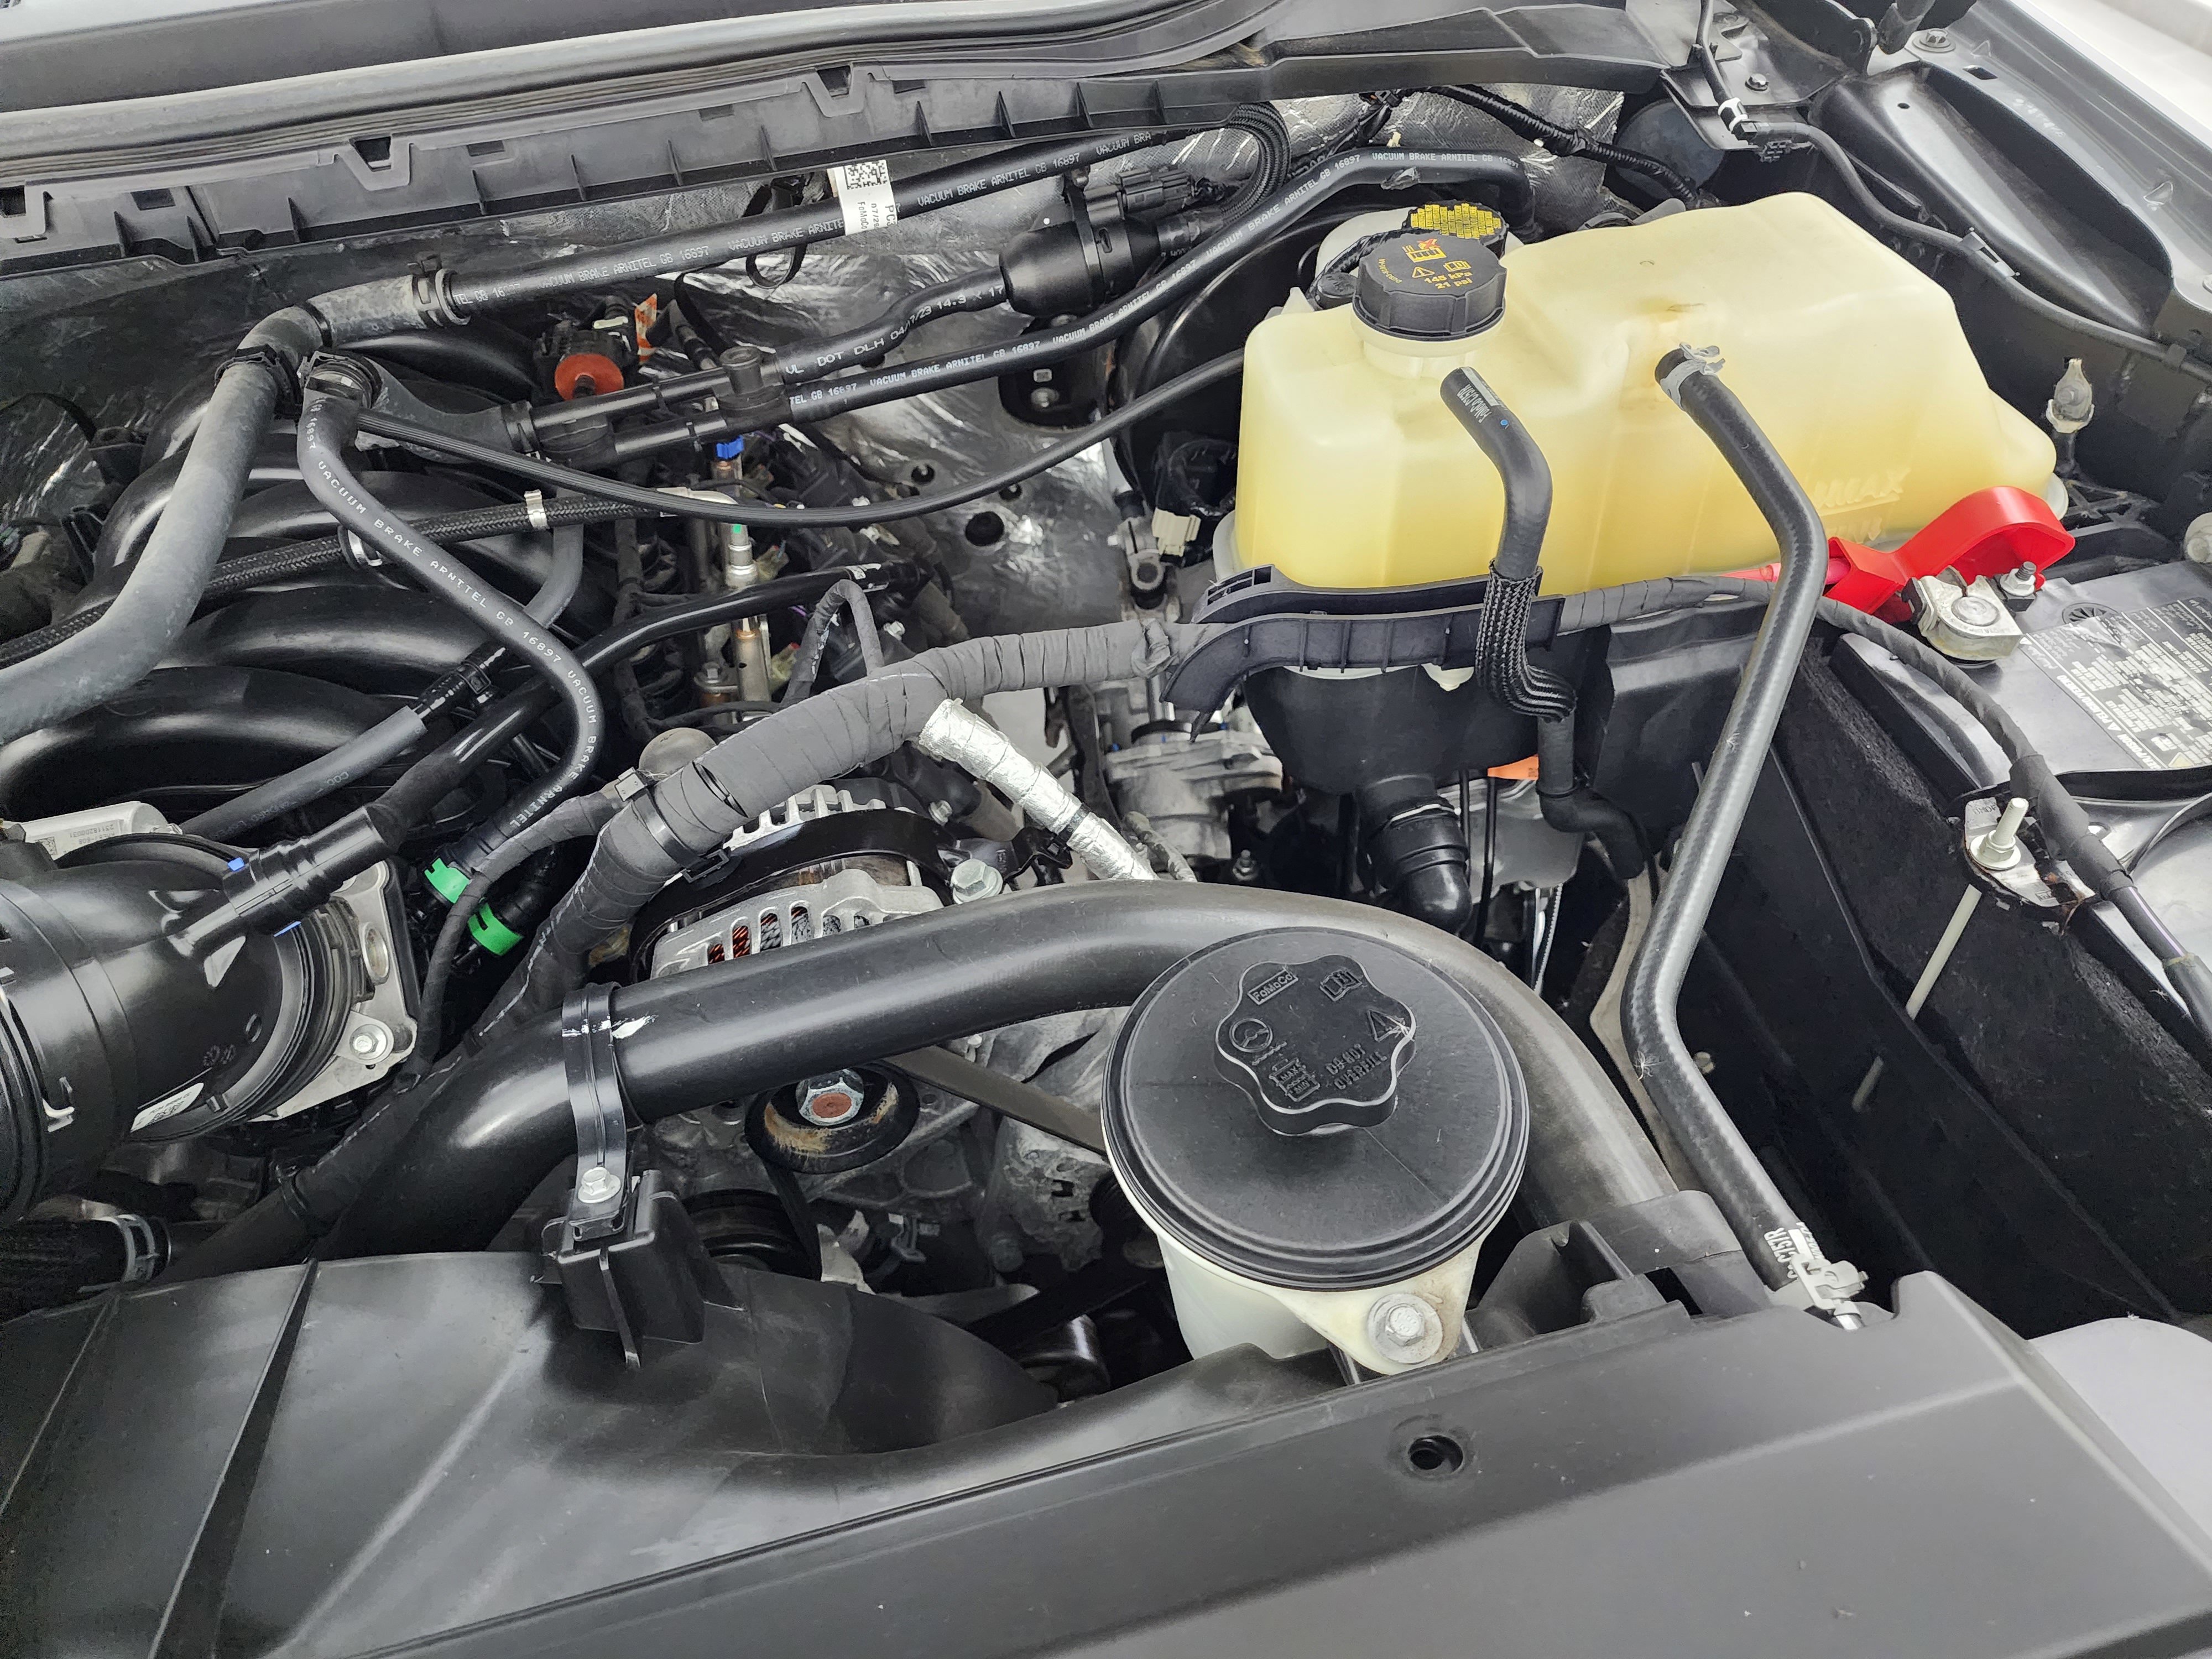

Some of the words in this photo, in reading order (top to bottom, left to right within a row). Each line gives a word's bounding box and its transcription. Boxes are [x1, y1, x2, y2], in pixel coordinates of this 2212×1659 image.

[1095, 138, 1130, 155] VACUUM
[1133, 132, 1151, 145] BRA
[1371, 152, 1405, 161] VACUUM
[1499, 156, 1519, 168] 16897
[917, 189, 953, 207] VACUUM
[956, 179, 987, 196] BRAKE
[991, 168, 1031, 186] ARNITEL
[1035, 162, 1047, 174] GB
[1052, 152, 1081, 169] 16897
[857, 201, 868, 229] FoMoCo
[1206, 230, 1244, 257] VACUUM
[1248, 204, 1281, 232] BRAKE
[1284, 179, 1319, 206] ARNITEL
[1319, 168, 1332, 180] GB
[1334, 154, 1361, 170] 16897
[728, 234, 768, 251] VACUUM
[771, 227, 804, 243] BRAKE
[808, 219, 844, 235] ARNITE
[579, 267, 610, 281] BRAKE
[613, 257, 656, 274] ARNITEL
[659, 253, 674, 264] GB
[680, 246, 709, 260] 16897
[1424, 274, 1447, 284] 145
[1449, 271, 1473, 280] kPa
[474, 289, 489, 302] GB
[1434, 281, 1452, 290] 21
[1455, 278, 1473, 287] psi
[1052, 327, 1086, 345] VACUUM
[1089, 312, 1115, 332] BRAKE
[1172, 259, 1196, 280] 16897
[817, 351, 845, 367] DOT
[854, 337, 885, 356] DLH
[890, 305, 932, 340] 04/17/23
[811, 390, 823, 401] GB
[828, 382, 858, 397] 16897
[869, 373, 906, 387] VACUUM
[911, 363, 940, 378] BRAKE
[945, 353, 988, 369] ARNITEL
[993, 348, 1006, 358] GB
[1011, 341, 1041, 356] 16897
[306, 416, 317, 450] 16897
[318, 461, 367, 514] VACUUM
[374, 518, 422, 557] BRAKE
[430, 560, 487, 608] ARNITEL
[496, 611, 514, 627] GB
[523, 631, 562, 663] 16897
[568, 670, 597, 723] VACUUM
[568, 735, 597, 780] BRAKE
[509, 784, 562, 827] ARNITEL
[1253, 973, 1293, 1000] FoMoCo
[1280, 1066, 1299, 1082] MAX
[1326, 1057, 1345, 1074] DO
[1342, 1044, 1366, 1063] NOT
[1334, 1051, 1387, 1089] OVERFILL
[1294, 1080, 1310, 1094] MIN
